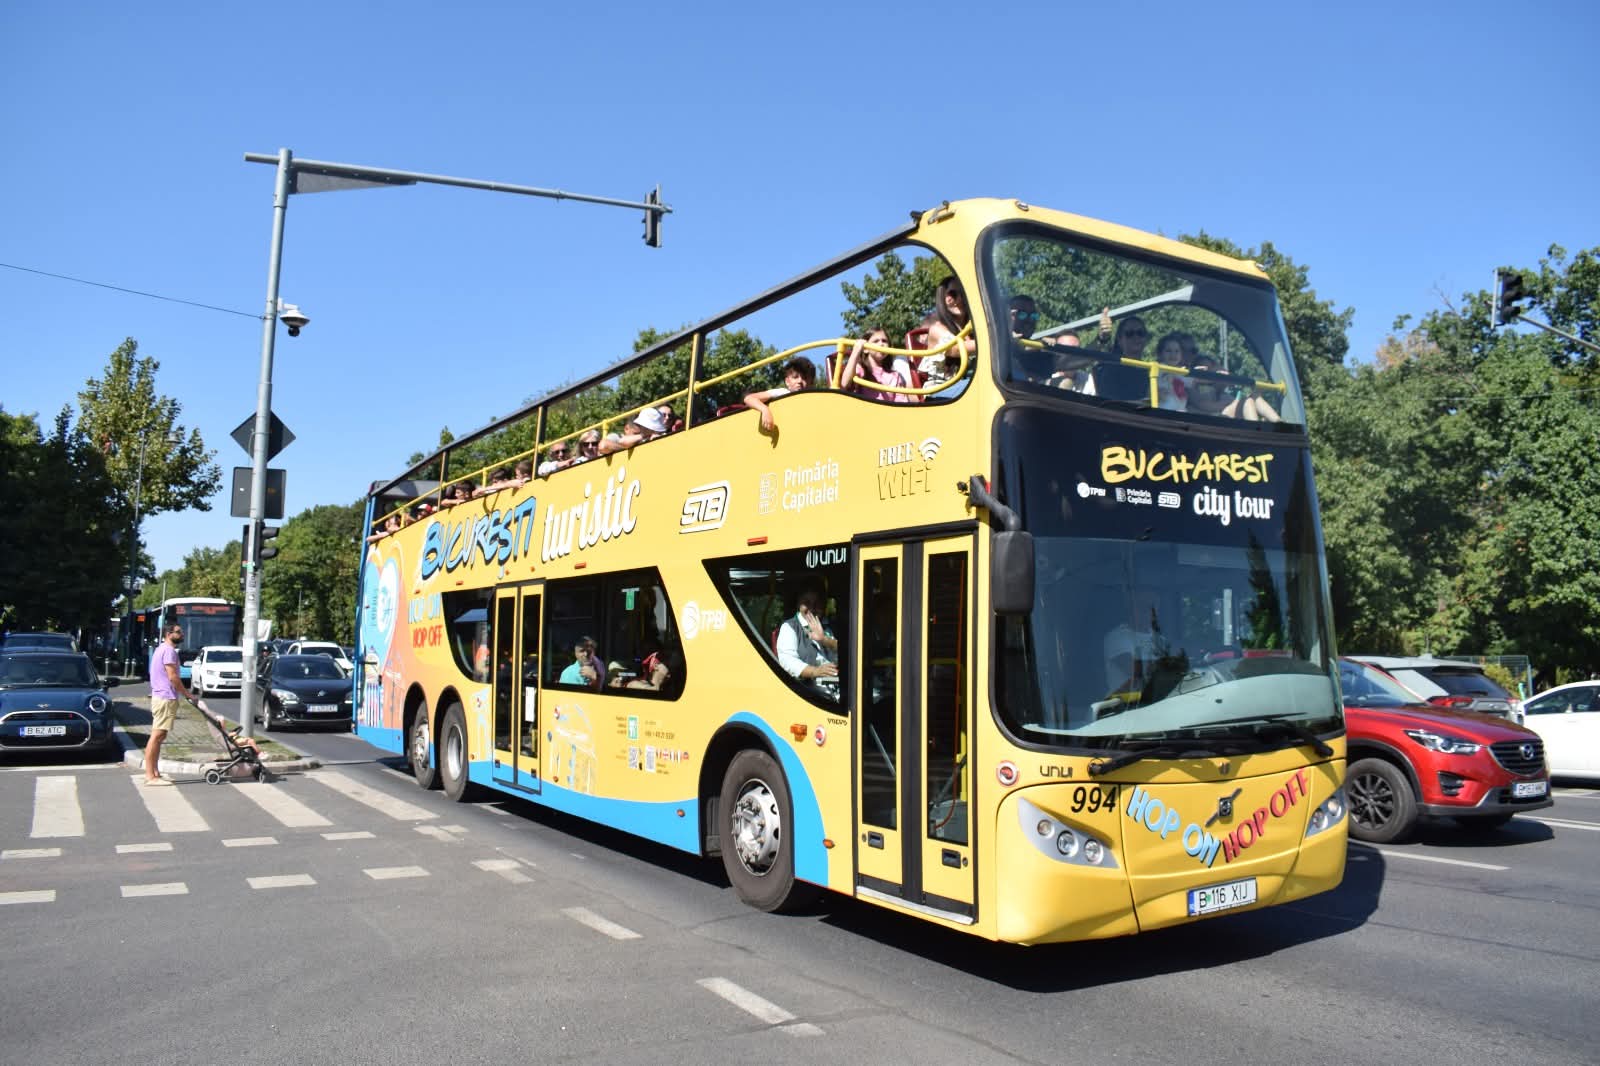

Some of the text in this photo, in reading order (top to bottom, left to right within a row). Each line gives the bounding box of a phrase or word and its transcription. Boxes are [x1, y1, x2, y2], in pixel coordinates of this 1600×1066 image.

[878, 442, 914, 468] FREE
[1101, 446, 1274, 484] BUCHAREST
[783, 457, 839, 488] Primăria
[680, 488, 728, 528] STB
[782, 479, 839, 513] Capitalei
[1193, 485, 1275, 526] city tour
[541, 466, 641, 564] turistic
[429, 625, 443, 647] OFF
[1071, 786, 1117, 813] 994
[1126, 766, 1311, 868] HOP ON HOP OFF
[1199, 882, 1248, 908] B 116 XIJ
